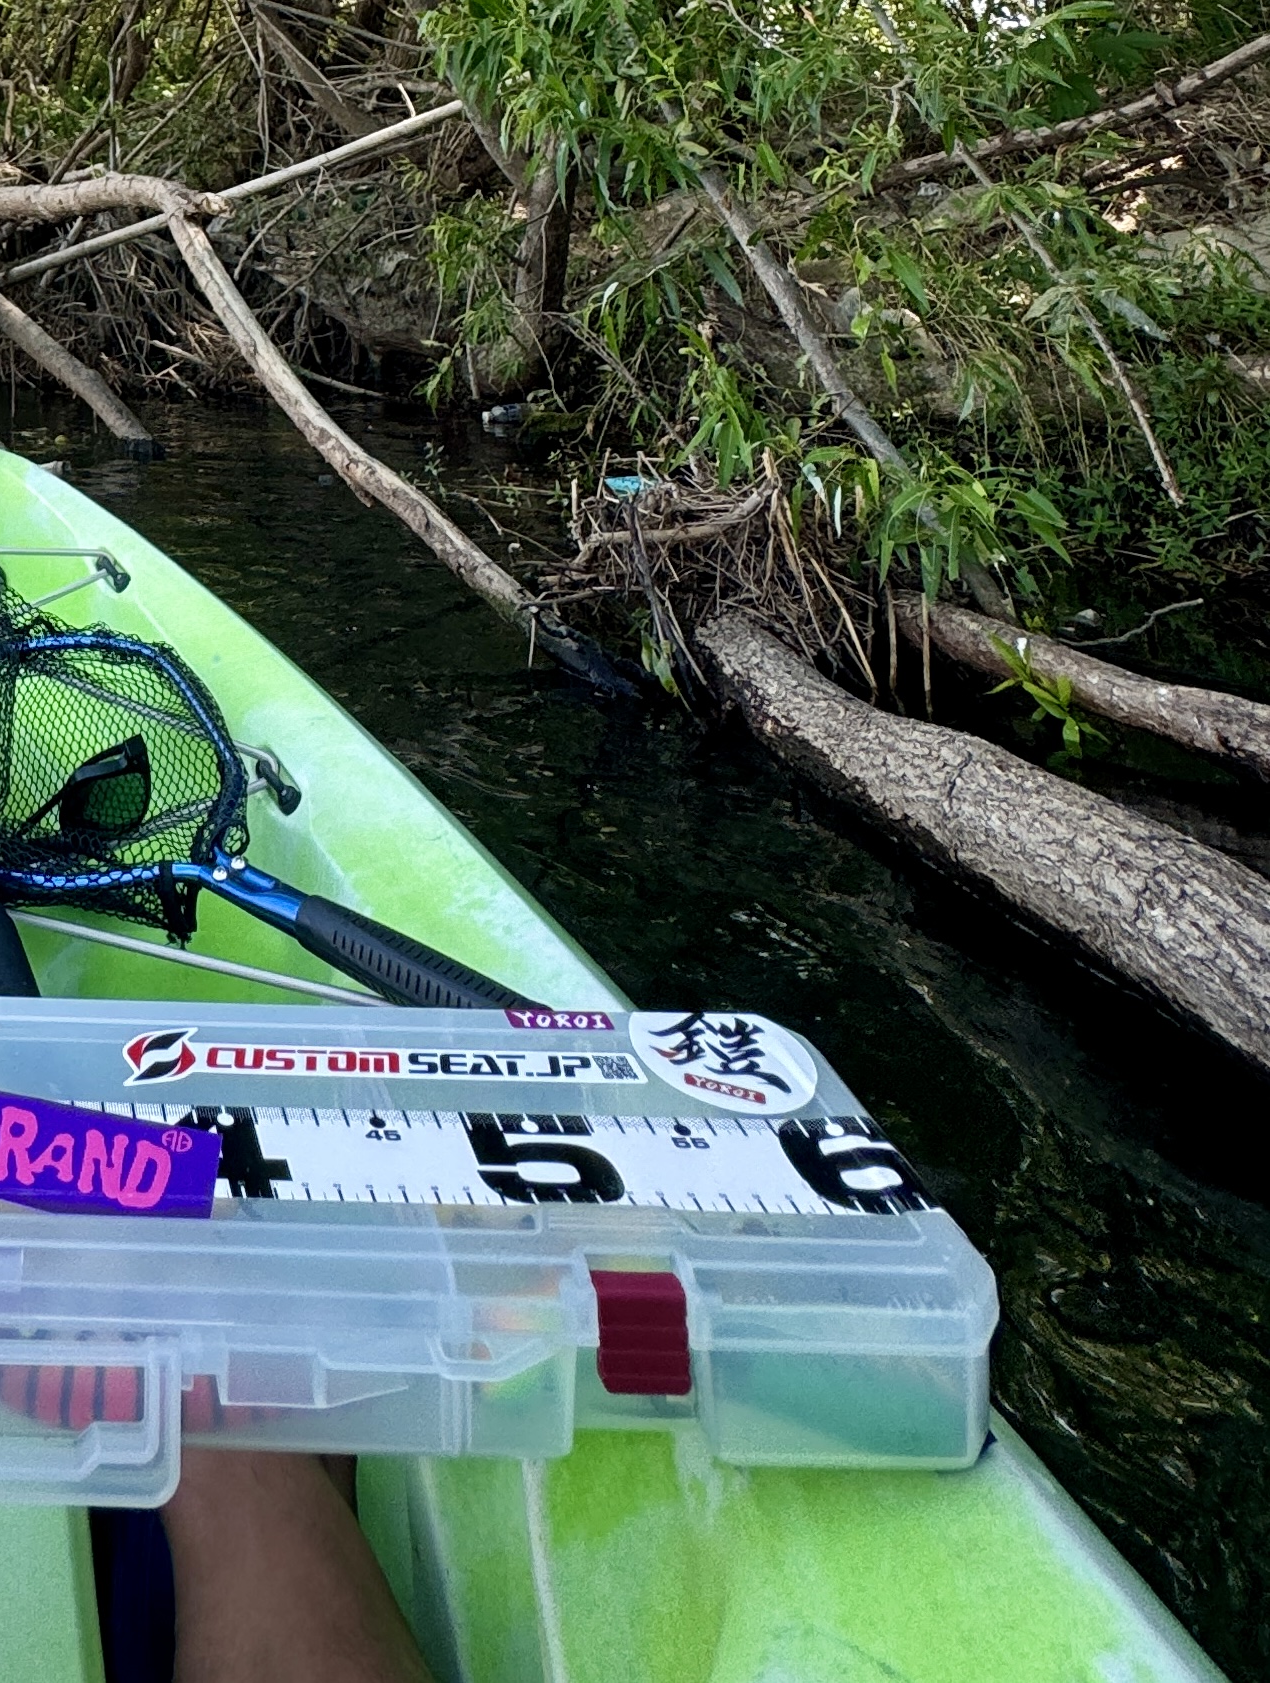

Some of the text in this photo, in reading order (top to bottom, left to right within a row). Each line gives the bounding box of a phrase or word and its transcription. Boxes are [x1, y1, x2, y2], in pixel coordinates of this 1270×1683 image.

[518, 1010, 607, 1029] YOROI
[648, 1012, 792, 1094] 鎧
[693, 1075, 758, 1102] YOROI
[365, 1129, 402, 1142] 45
[671, 1136, 710, 1150] 55
[462, 1112, 627, 1204] 5
[779, 1116, 938, 1214] 6
